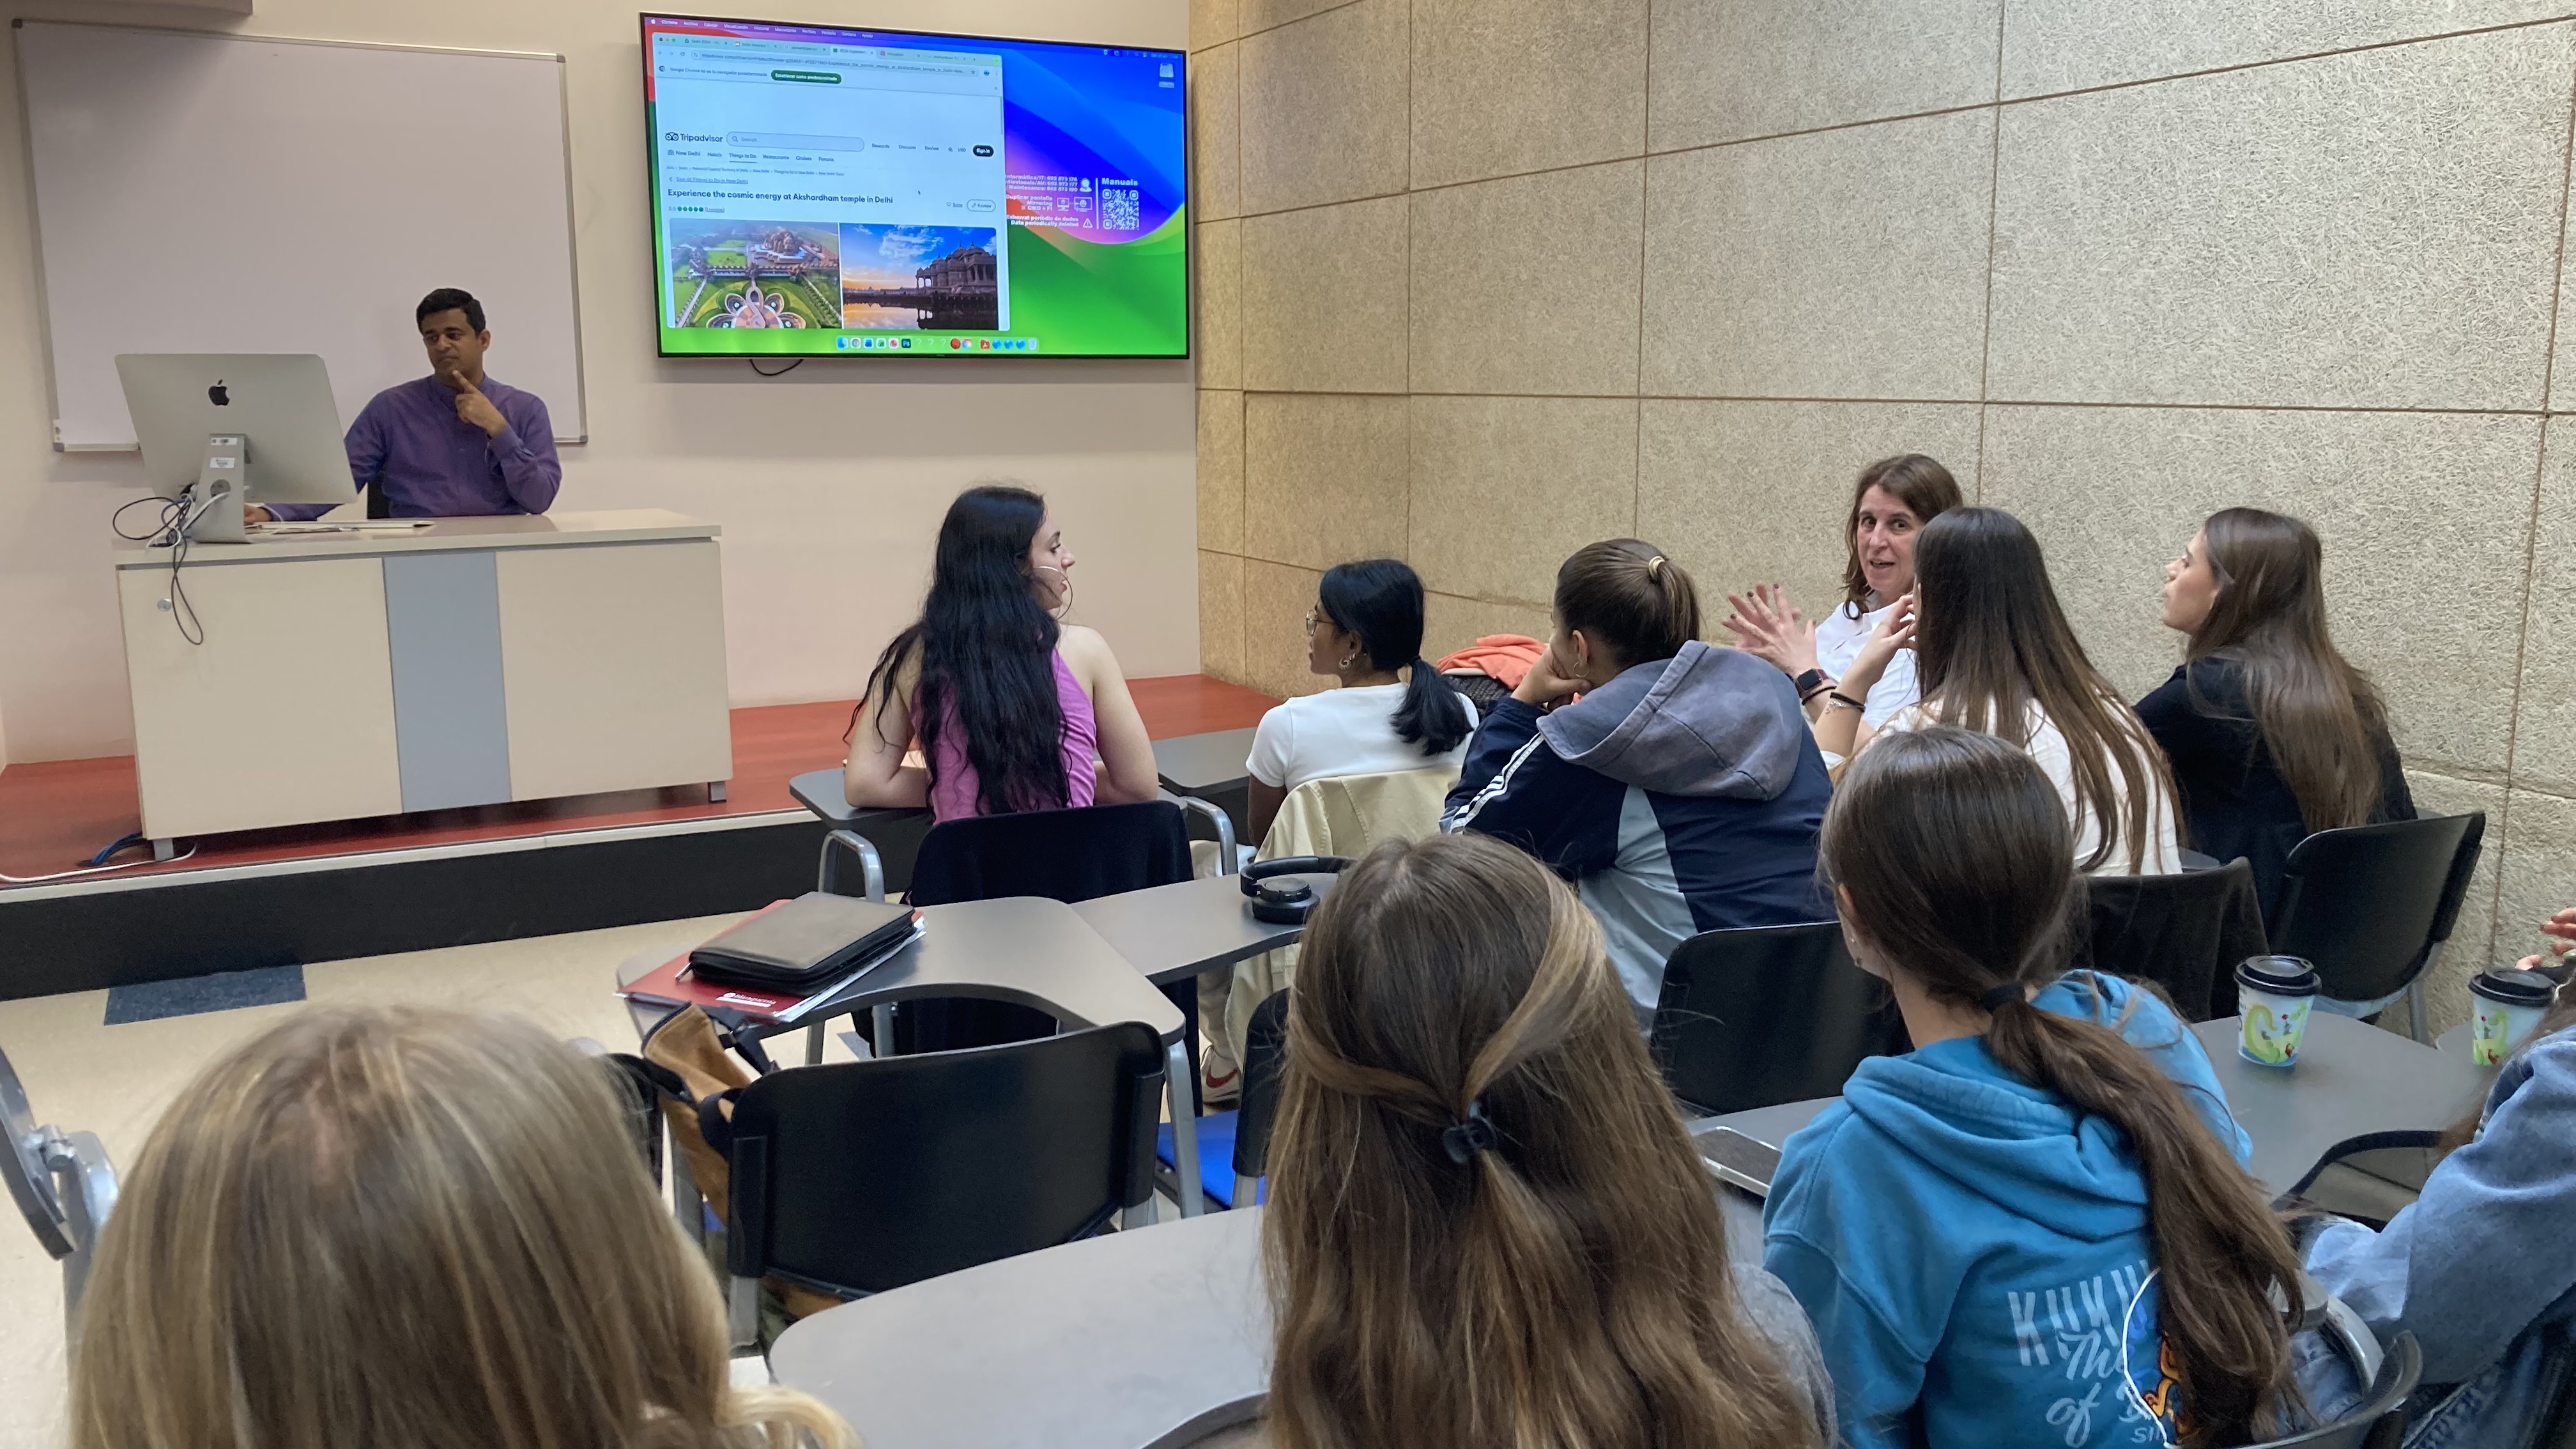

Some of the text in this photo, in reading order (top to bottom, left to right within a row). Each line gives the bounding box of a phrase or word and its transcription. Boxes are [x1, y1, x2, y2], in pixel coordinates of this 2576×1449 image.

[680, 134, 723, 142] Tripadvisor
[1101, 178, 1138, 186] Manuals
[668, 189, 711, 198] Experience
[727, 191, 754, 199] cosmic
[755, 193, 781, 201] energy
[793, 194, 839, 202] Akshardham
[841, 195, 866, 204] temple
